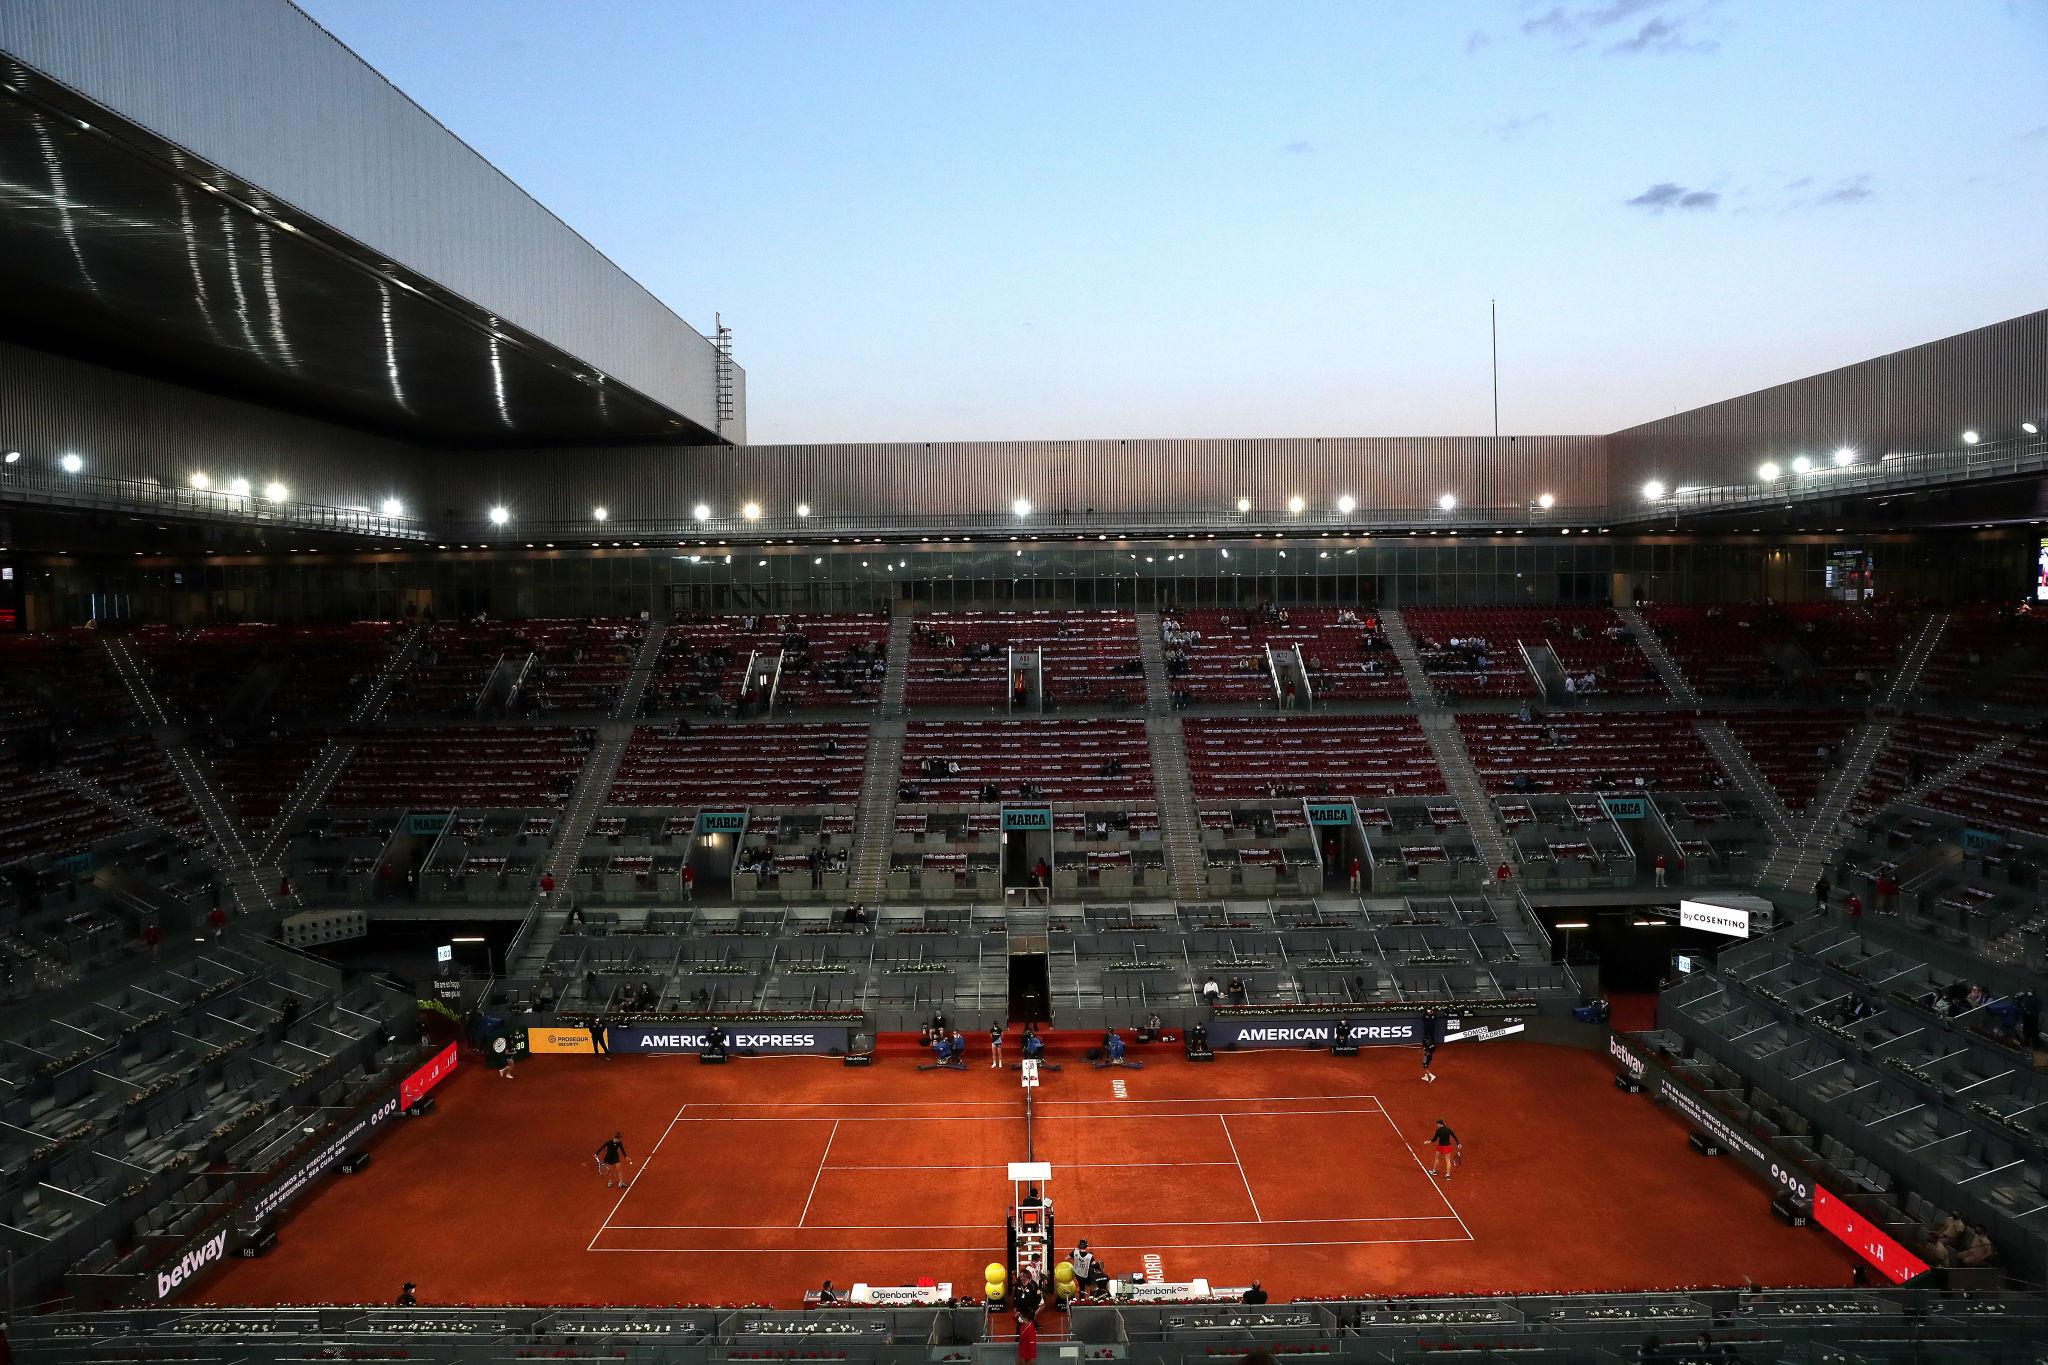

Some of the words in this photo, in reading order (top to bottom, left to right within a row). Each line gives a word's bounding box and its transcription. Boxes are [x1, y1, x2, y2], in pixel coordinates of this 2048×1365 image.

[1006, 814, 1046, 826] MARCA
[1309, 810, 1348, 821] MARCA
[706, 817, 744, 829] MARCA
[1684, 912, 1693, 922] by
[1693, 914, 1746, 929] COSENTINO
[1237, 1028, 1329, 1041] AMERICAN
[1334, 1026, 1413, 1039] XPRESS
[1463, 1026, 1488, 1037] SOMOS
[1479, 1030, 1506, 1041] MADRID
[640, 1035, 730, 1047] AMERICN
[736, 1035, 815, 1047] EXPRESS
[1610, 1035, 1645, 1078] betway
[1702, 1109, 1721, 1127] PRECIO
[1730, 1130, 1765, 1161] CUALQUIERA
[1713, 1127, 1728, 1143] CUAL
[1708, 1148, 1718, 1156] RH
[269, 1175, 297, 1202] BAJAMOS
[306, 1152, 327, 1171] PRECIO
[265, 1200, 278, 1214] TUS
[308, 1167, 320, 1179] SEA
[320, 1155, 334, 1169] CUAL
[1794, 1218, 1806, 1226] RH
[243, 1248, 255, 1257] RH
[157, 1229, 227, 1299] betway
[872, 1291, 918, 1300] Openbank
[1132, 1286, 1177, 1296] Openbank
